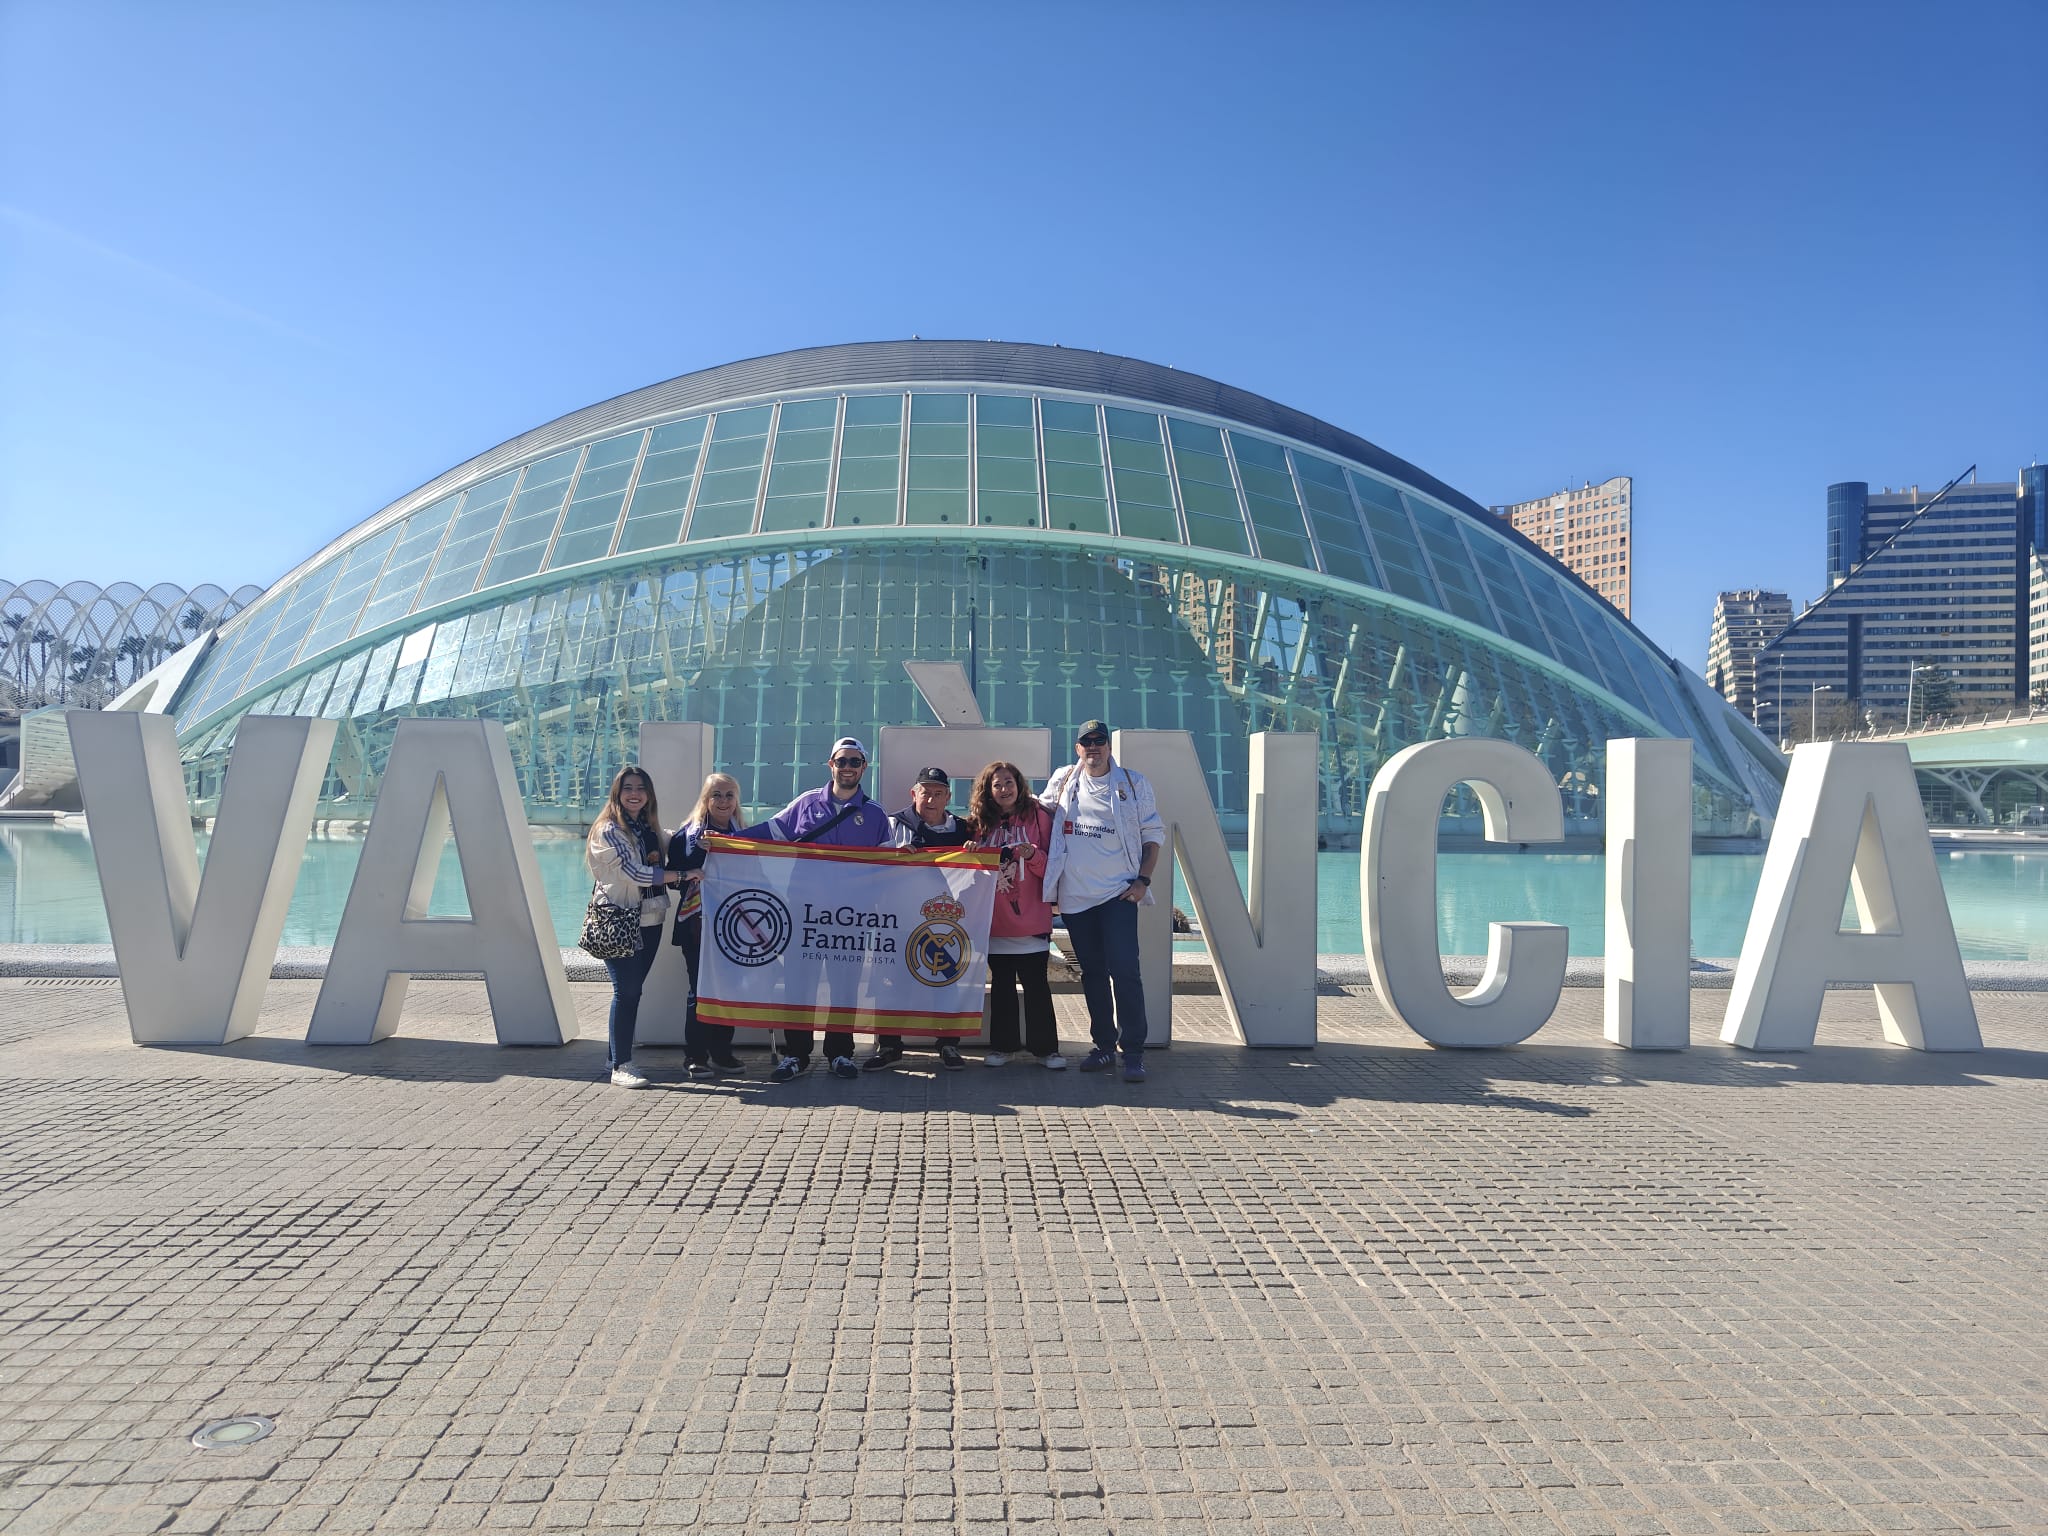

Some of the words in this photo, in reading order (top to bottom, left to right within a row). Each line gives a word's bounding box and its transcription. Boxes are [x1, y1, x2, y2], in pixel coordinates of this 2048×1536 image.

[1074, 822, 1115, 835] Universidad
[1074, 829, 1102, 839] Europea
[801, 928, 897, 953] Familia
[802, 952, 829, 961] PEÑA
[833, 955, 896, 965] MADRDISTA
